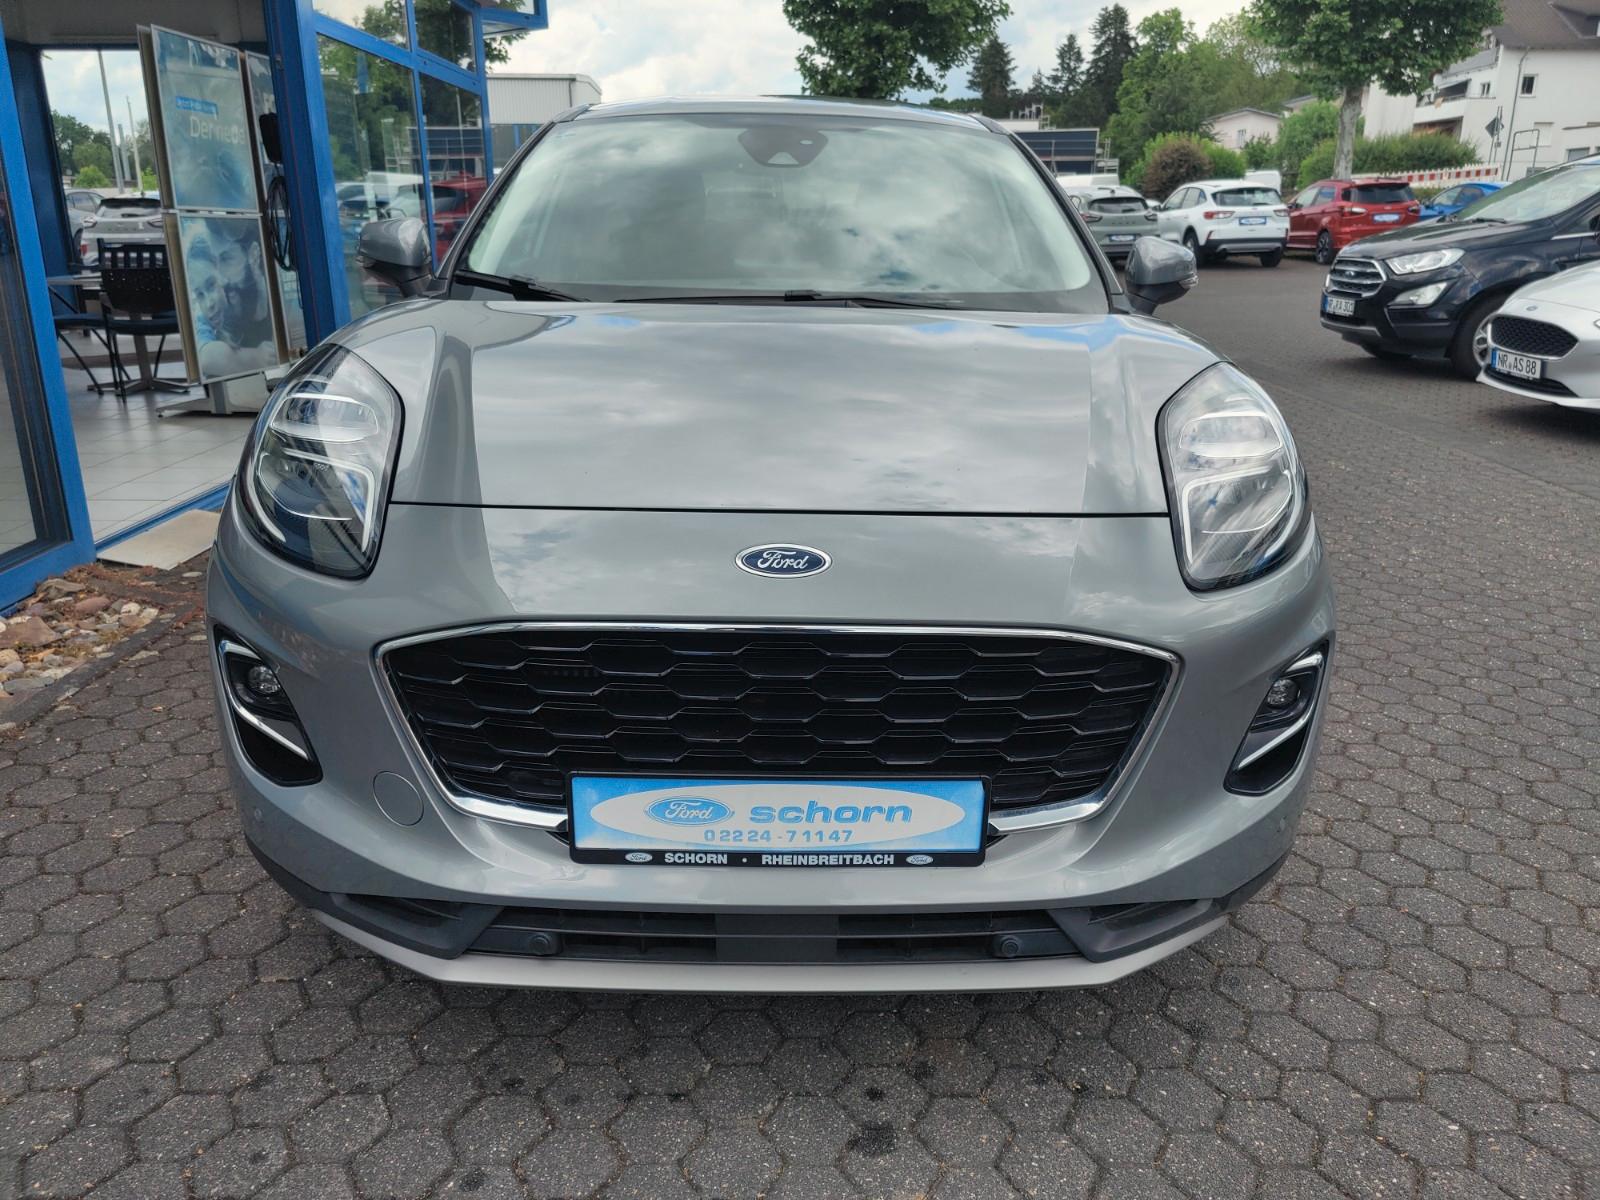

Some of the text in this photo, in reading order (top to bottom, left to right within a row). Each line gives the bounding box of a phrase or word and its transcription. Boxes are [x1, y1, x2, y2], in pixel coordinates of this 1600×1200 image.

[1498, 352, 1537, 376] NR AS 88
[757, 550, 810, 569] Ford
[664, 799, 913, 825] Ford schorn
[664, 852, 728, 865] SCHORN
[761, 854, 894, 866] RHEINBREITBACH
